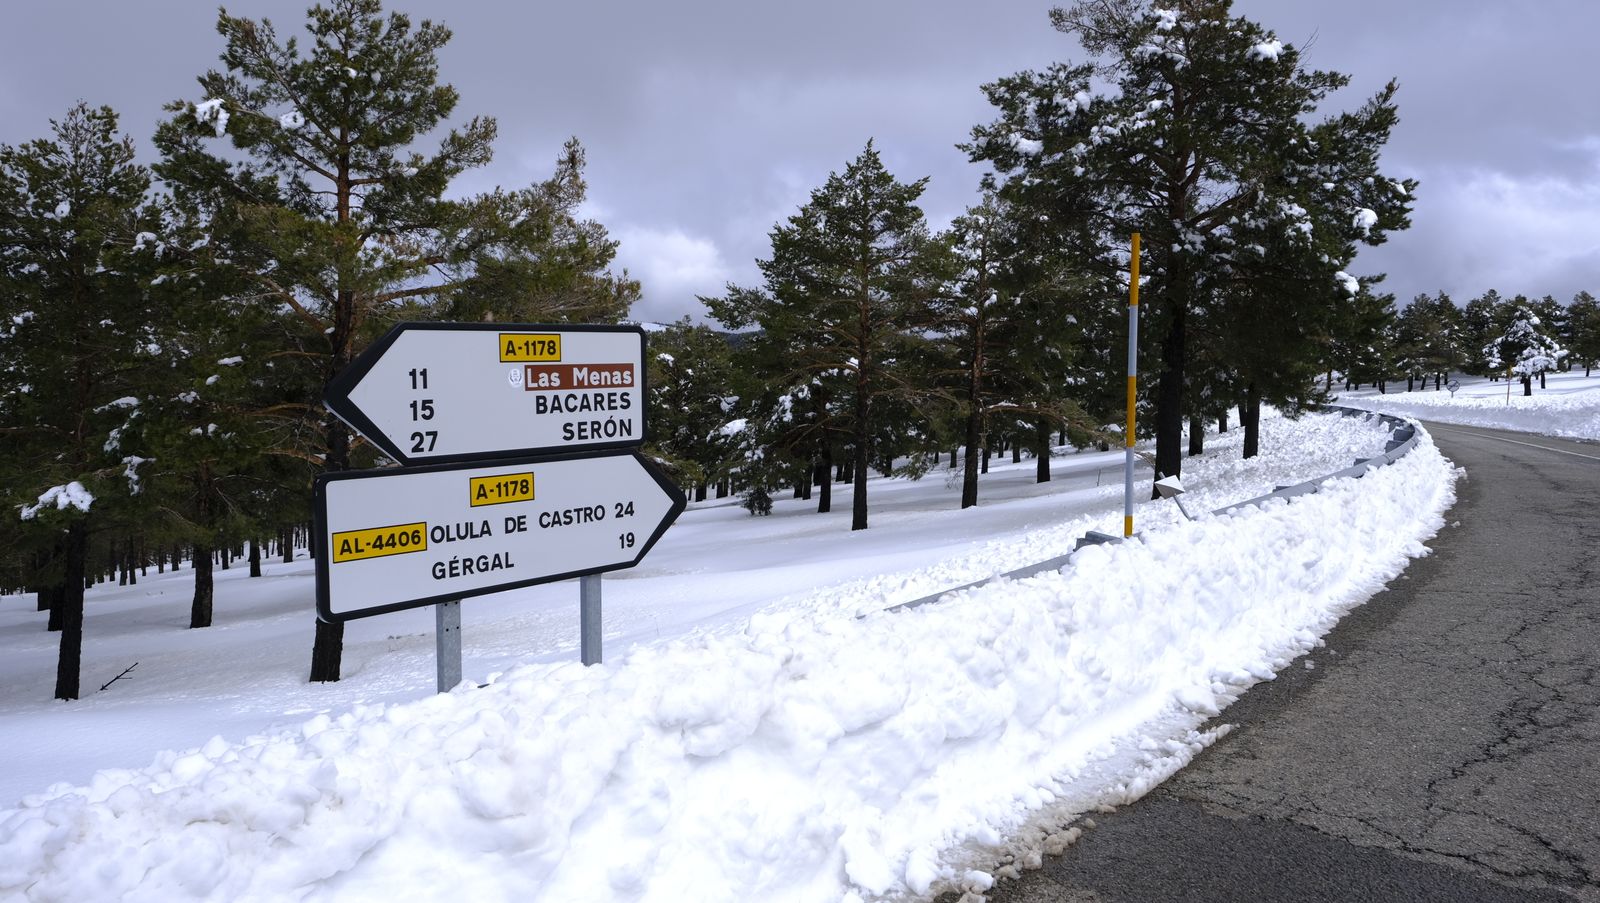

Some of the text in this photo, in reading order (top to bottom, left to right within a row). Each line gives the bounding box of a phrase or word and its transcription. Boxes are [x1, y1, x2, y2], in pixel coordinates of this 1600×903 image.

[505, 340, 557, 357] A-1178
[409, 368, 427, 389] 11
[527, 369, 561, 387] Las
[573, 367, 632, 386] Menas
[410, 399, 435, 421] 15
[536, 392, 631, 414] BACARES
[563, 416, 632, 441] SERÓN
[411, 431, 438, 453] 27
[476, 479, 530, 500] A-1178
[431, 502, 634, 543] OLULA DE CASTRO 24
[340, 530, 421, 556] AL-4406
[620, 532, 635, 549] 19
[432, 552, 514, 579] GÉRGAL
